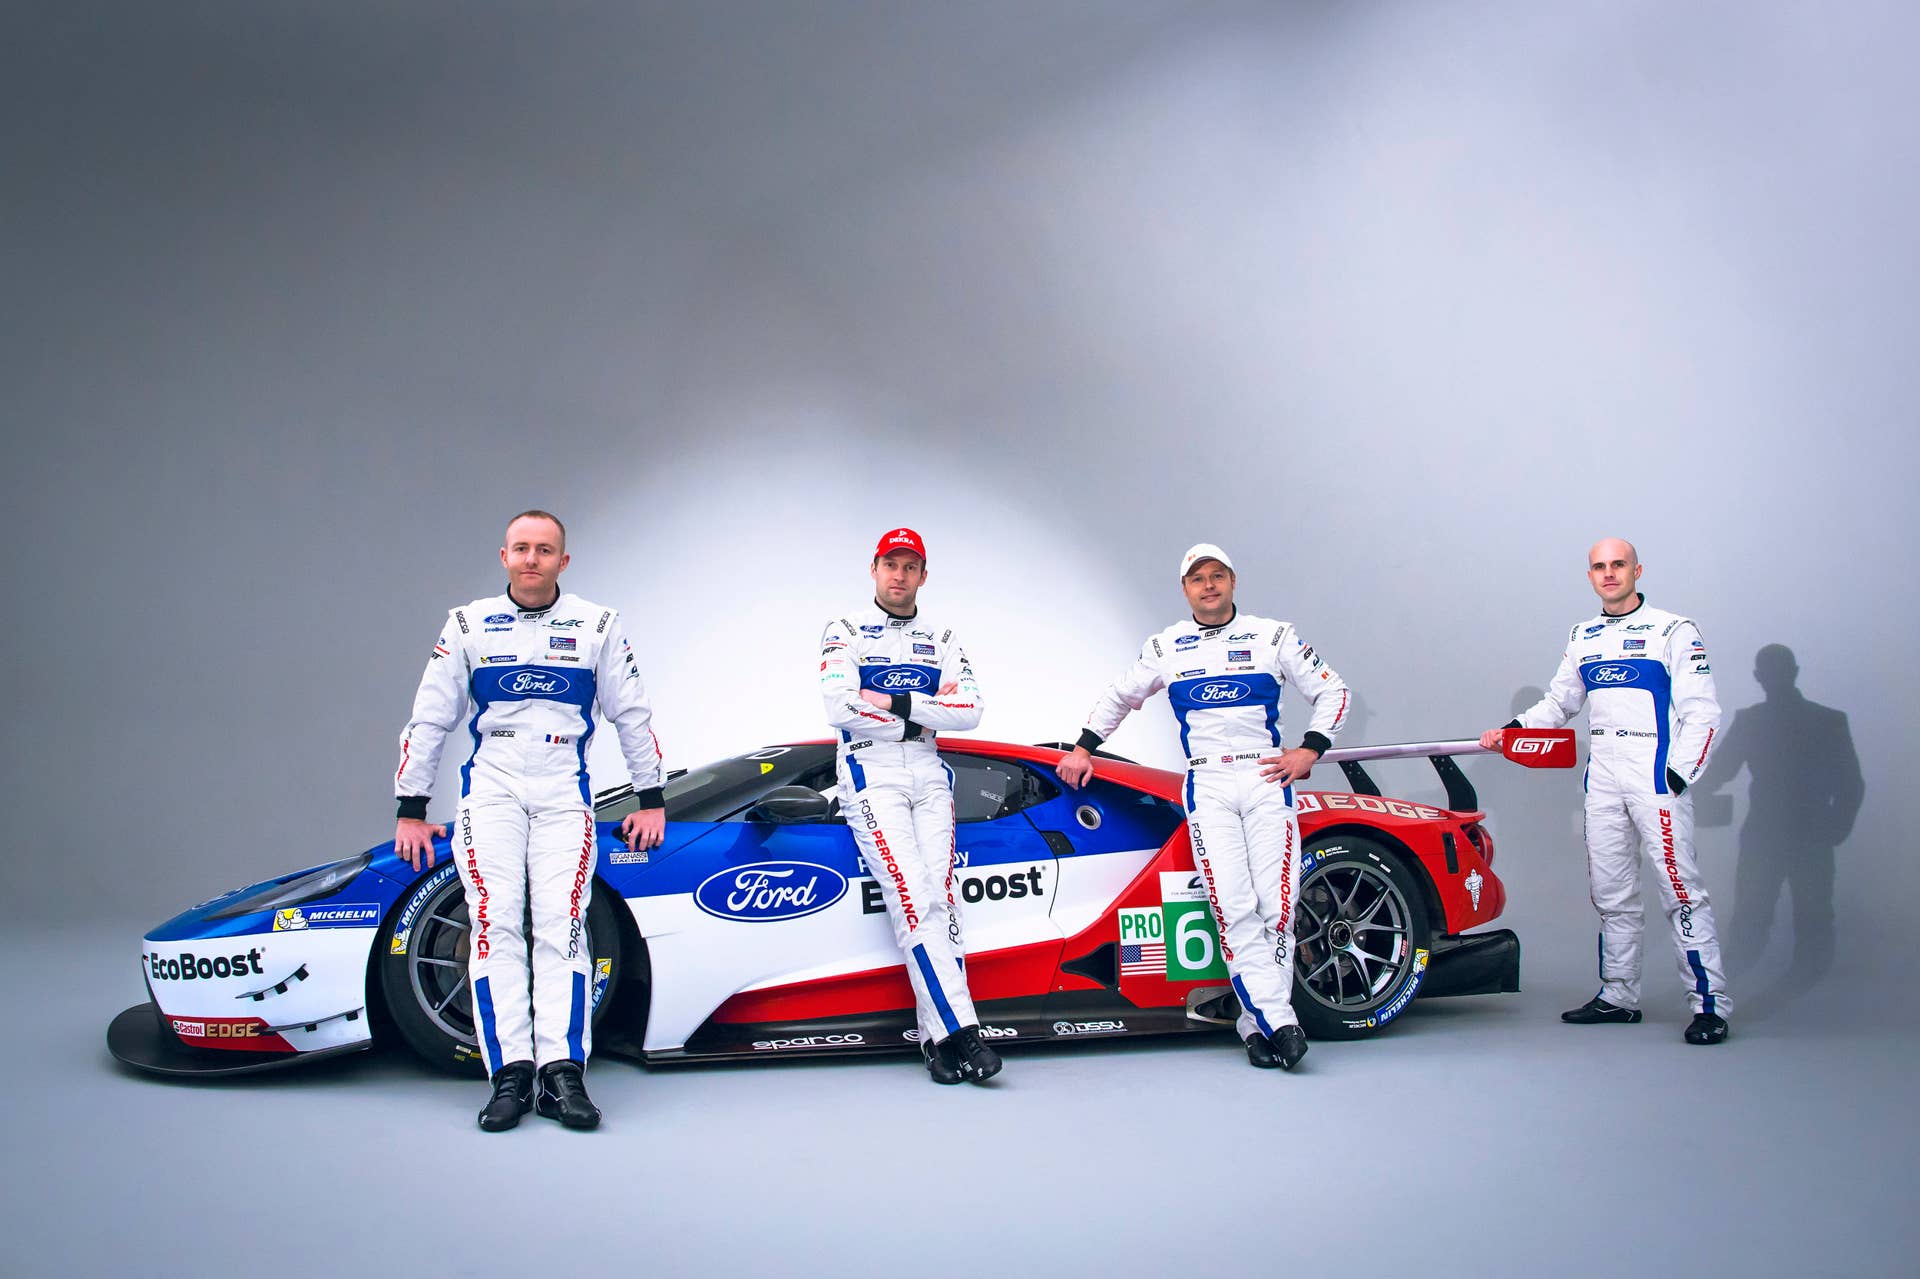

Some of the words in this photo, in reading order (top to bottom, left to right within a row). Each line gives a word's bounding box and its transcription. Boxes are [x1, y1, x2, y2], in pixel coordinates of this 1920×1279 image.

[889, 537, 914, 545] DEKRA
[551, 618, 584, 627] WEC
[513, 672, 555, 693] Ford
[884, 671, 921, 688] Ford
[1596, 668, 1627, 681] Ford
[1202, 685, 1239, 700] Ford
[1235, 753, 1261, 761] PRIAULX
[1511, 737, 1569, 755] GT
[1322, 794, 1449, 820] EDGE
[461, 808, 473, 846] FORD
[1192, 822, 1206, 857] FORD
[859, 799, 877, 830] FORD
[872, 830, 918, 932] PERFORMANCE
[1659, 809, 1692, 904] PERFORMANCE
[727, 869, 819, 911] Ford
[1276, 820, 1294, 932] PERFORMANCE
[401, 864, 457, 927] MICHELIN
[309, 909, 378, 920] MICHELIN
[1121, 913, 1161, 940] PRO
[1680, 904, 1694, 937] FORD
[568, 918, 581, 959] FORD
[1175, 911, 1214, 970] 6
[1274, 929, 1287, 967] FORD
[151, 948, 263, 980] EcoBoost
[1380, 976, 1419, 1022] MICHELIN
[178, 1022, 203, 1035] Castrol
[206, 1022, 260, 1037] EDGE
[1075, 1021, 1123, 1032] DSSV
